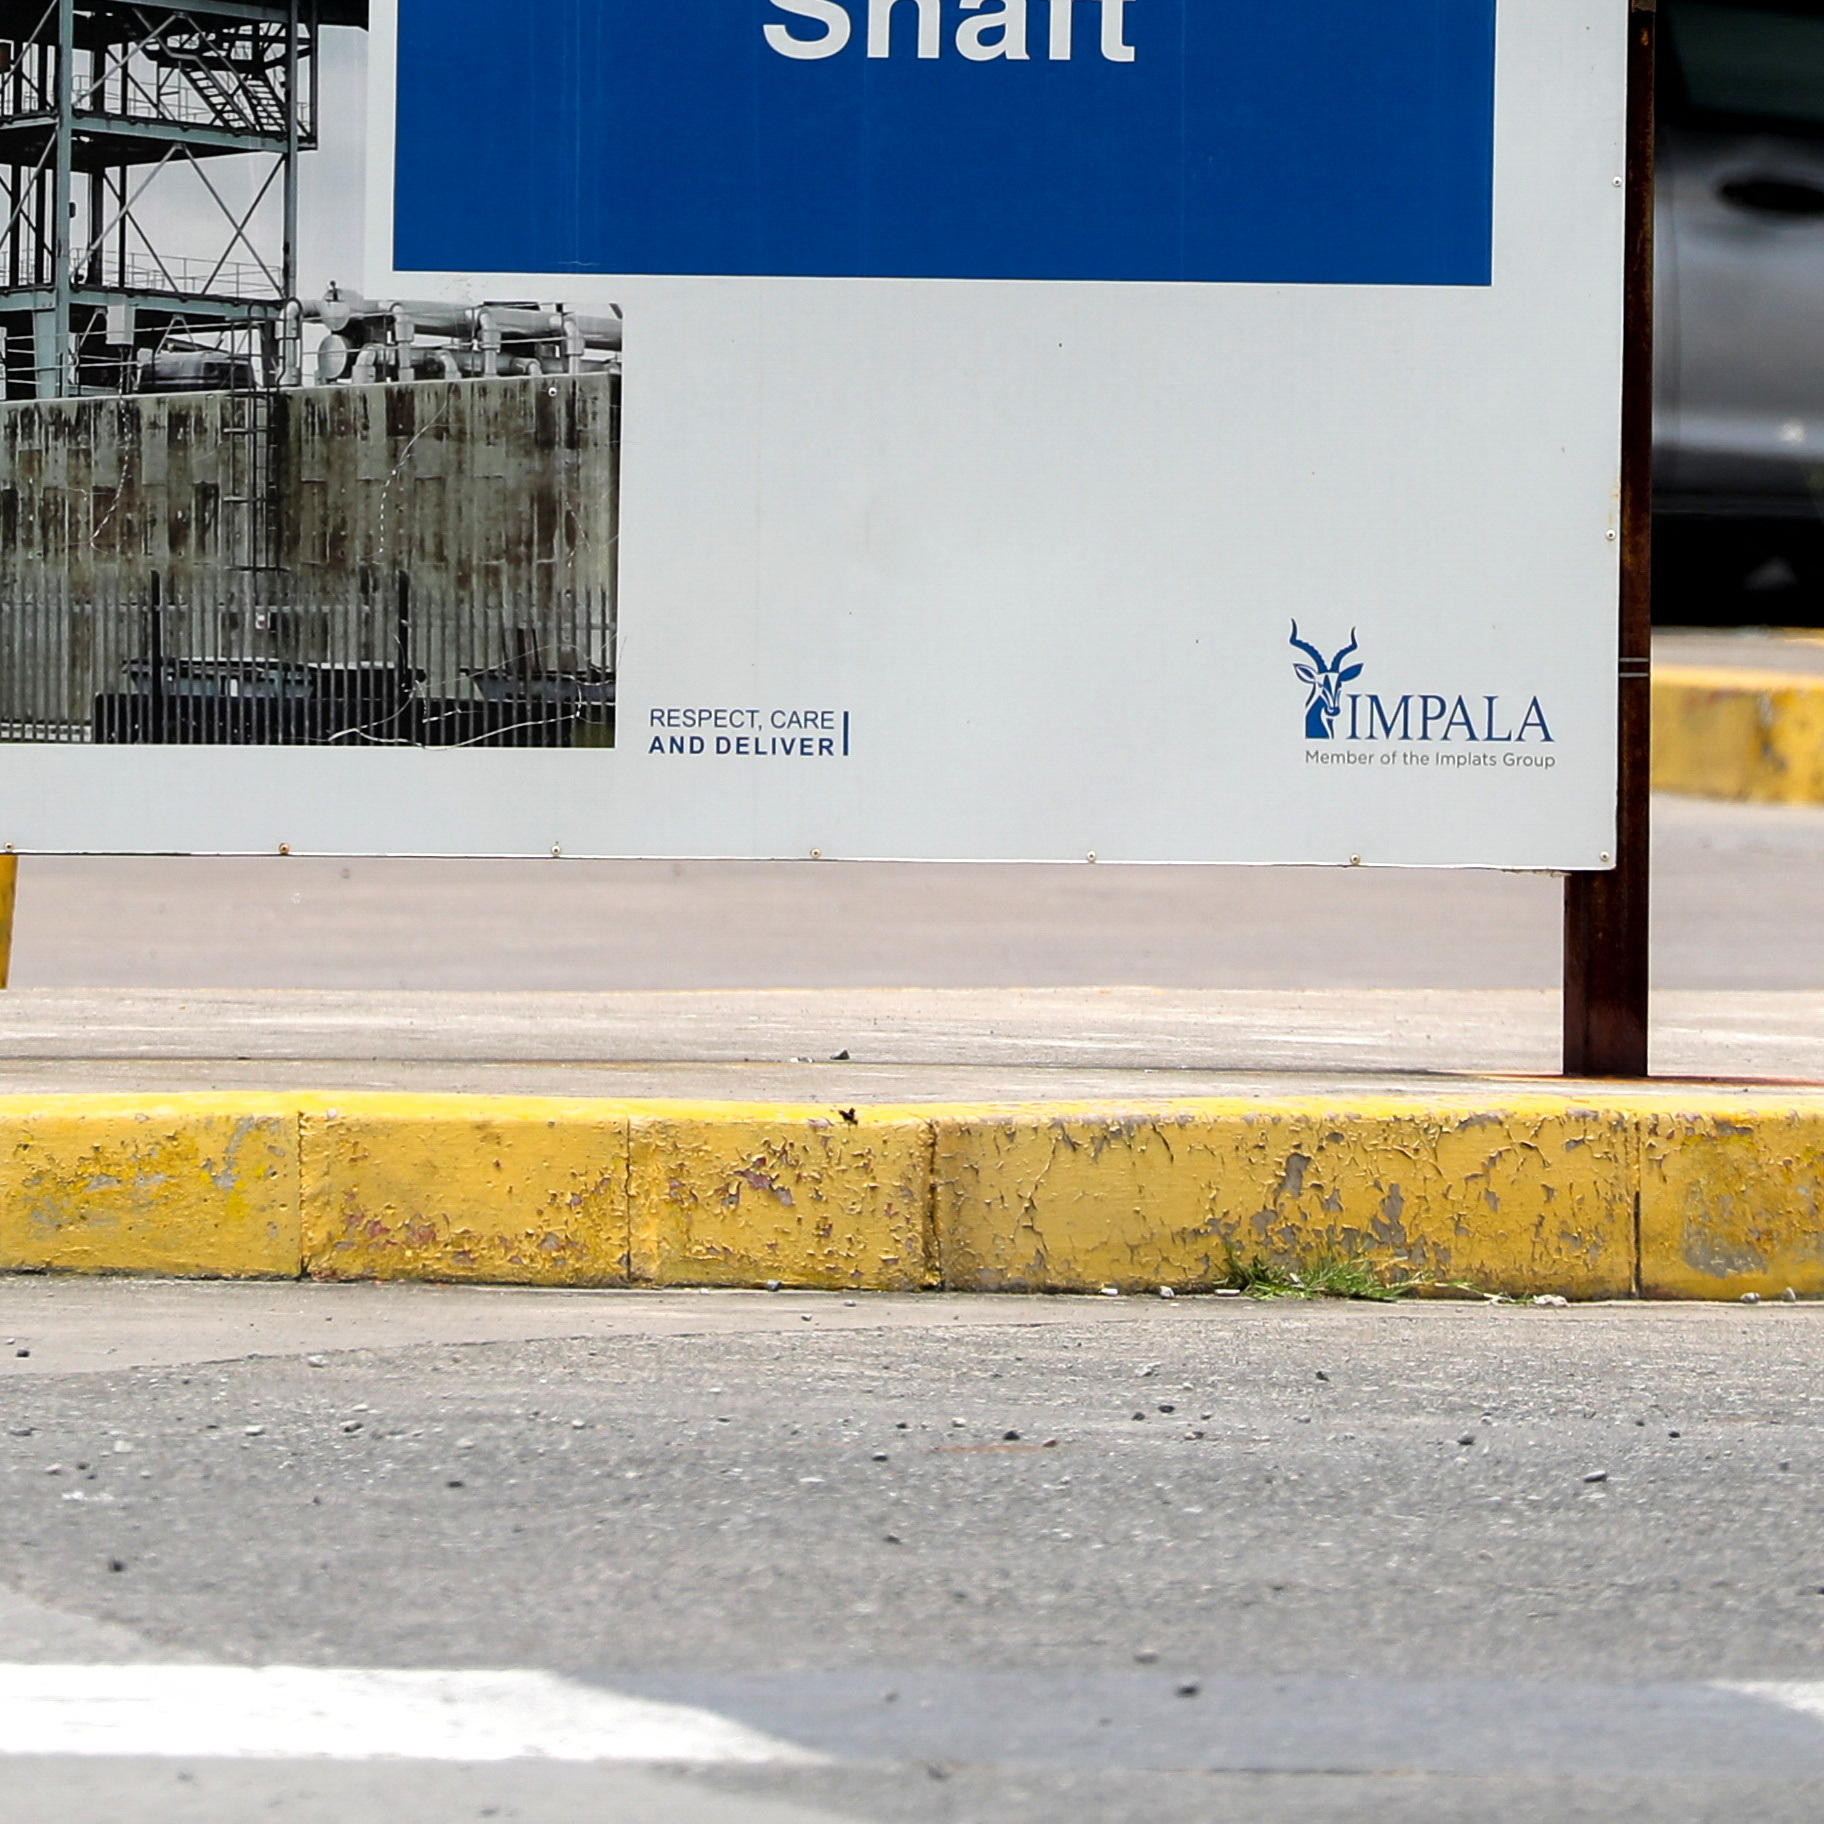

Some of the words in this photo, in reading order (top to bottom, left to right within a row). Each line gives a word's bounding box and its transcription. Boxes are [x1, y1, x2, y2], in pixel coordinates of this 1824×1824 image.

[649, 708, 763, 732] RESPECT,
[770, 710, 835, 730] CARE
[1346, 693, 1556, 743] IMPALA
[648, 736, 705, 755] AND
[715, 736, 835, 756] DELIVER
[1305, 750, 1375, 765] Member
[1380, 751, 1398, 766] of
[1402, 751, 1430, 765] the
[1435, 752, 1498, 770] Implats
[1503, 753, 1556, 770] Group
